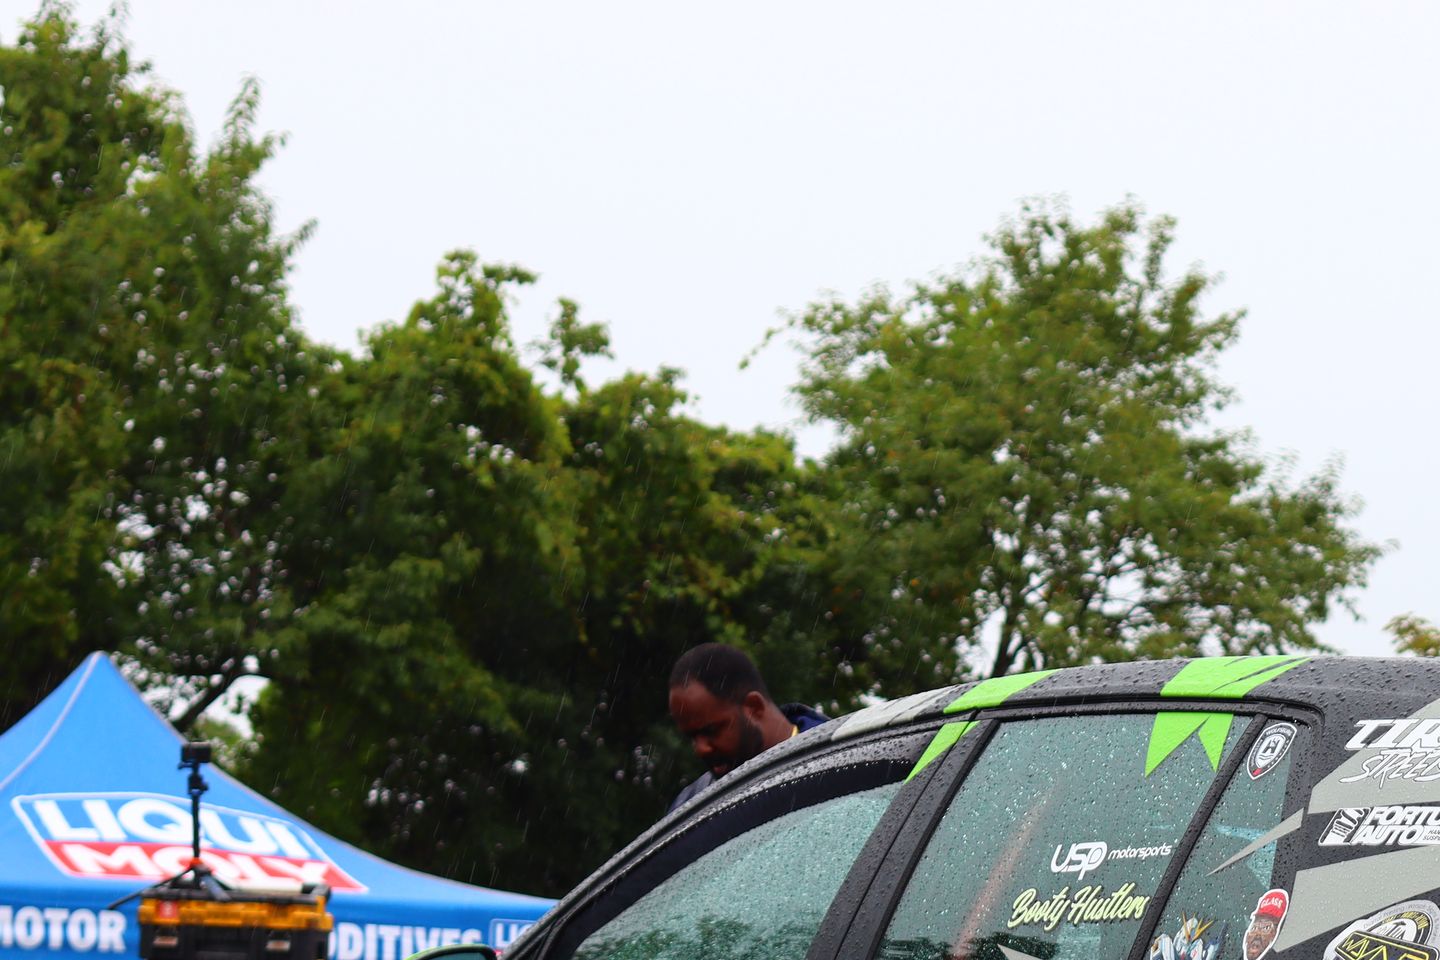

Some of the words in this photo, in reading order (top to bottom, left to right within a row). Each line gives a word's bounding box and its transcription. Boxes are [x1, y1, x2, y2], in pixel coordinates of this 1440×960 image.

[33, 798, 312, 859] LIQUI
[1107, 842, 1173, 860] motorsports
[1350, 825, 1424, 845] AUTO
[62, 844, 331, 889] MOLY
[1007, 886, 1072, 931] Booty
[1067, 882, 1150, 925] Hustlers
